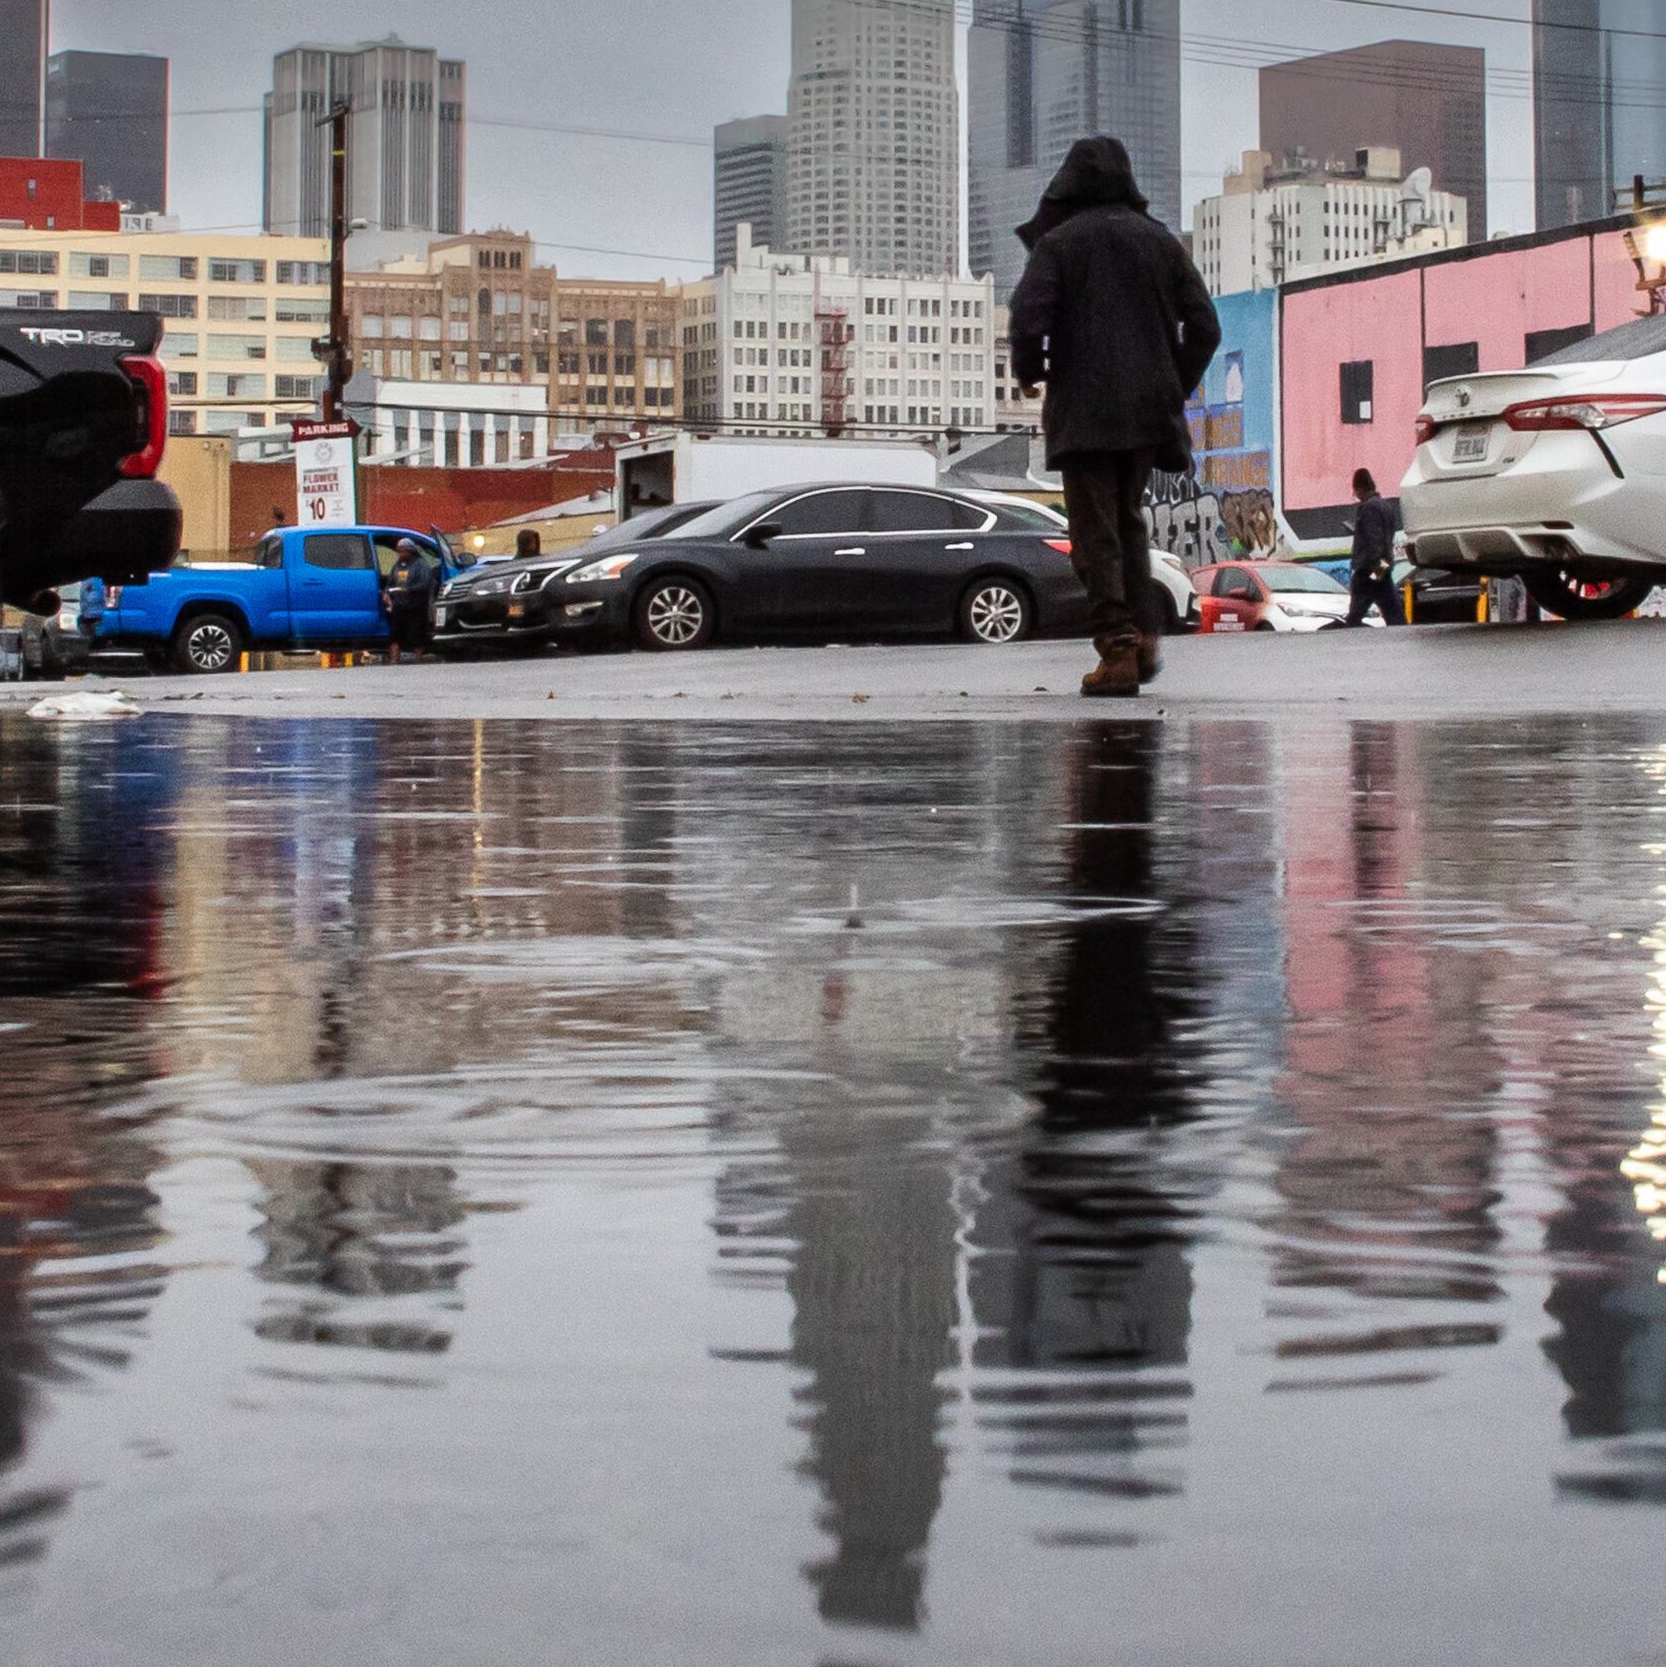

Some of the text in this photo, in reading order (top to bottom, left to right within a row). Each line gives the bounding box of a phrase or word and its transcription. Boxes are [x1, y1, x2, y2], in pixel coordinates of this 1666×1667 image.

[298, 422, 350, 436] PARKING
[303, 473, 339, 484] FLOWER
[303, 483, 339, 494] MARKET
